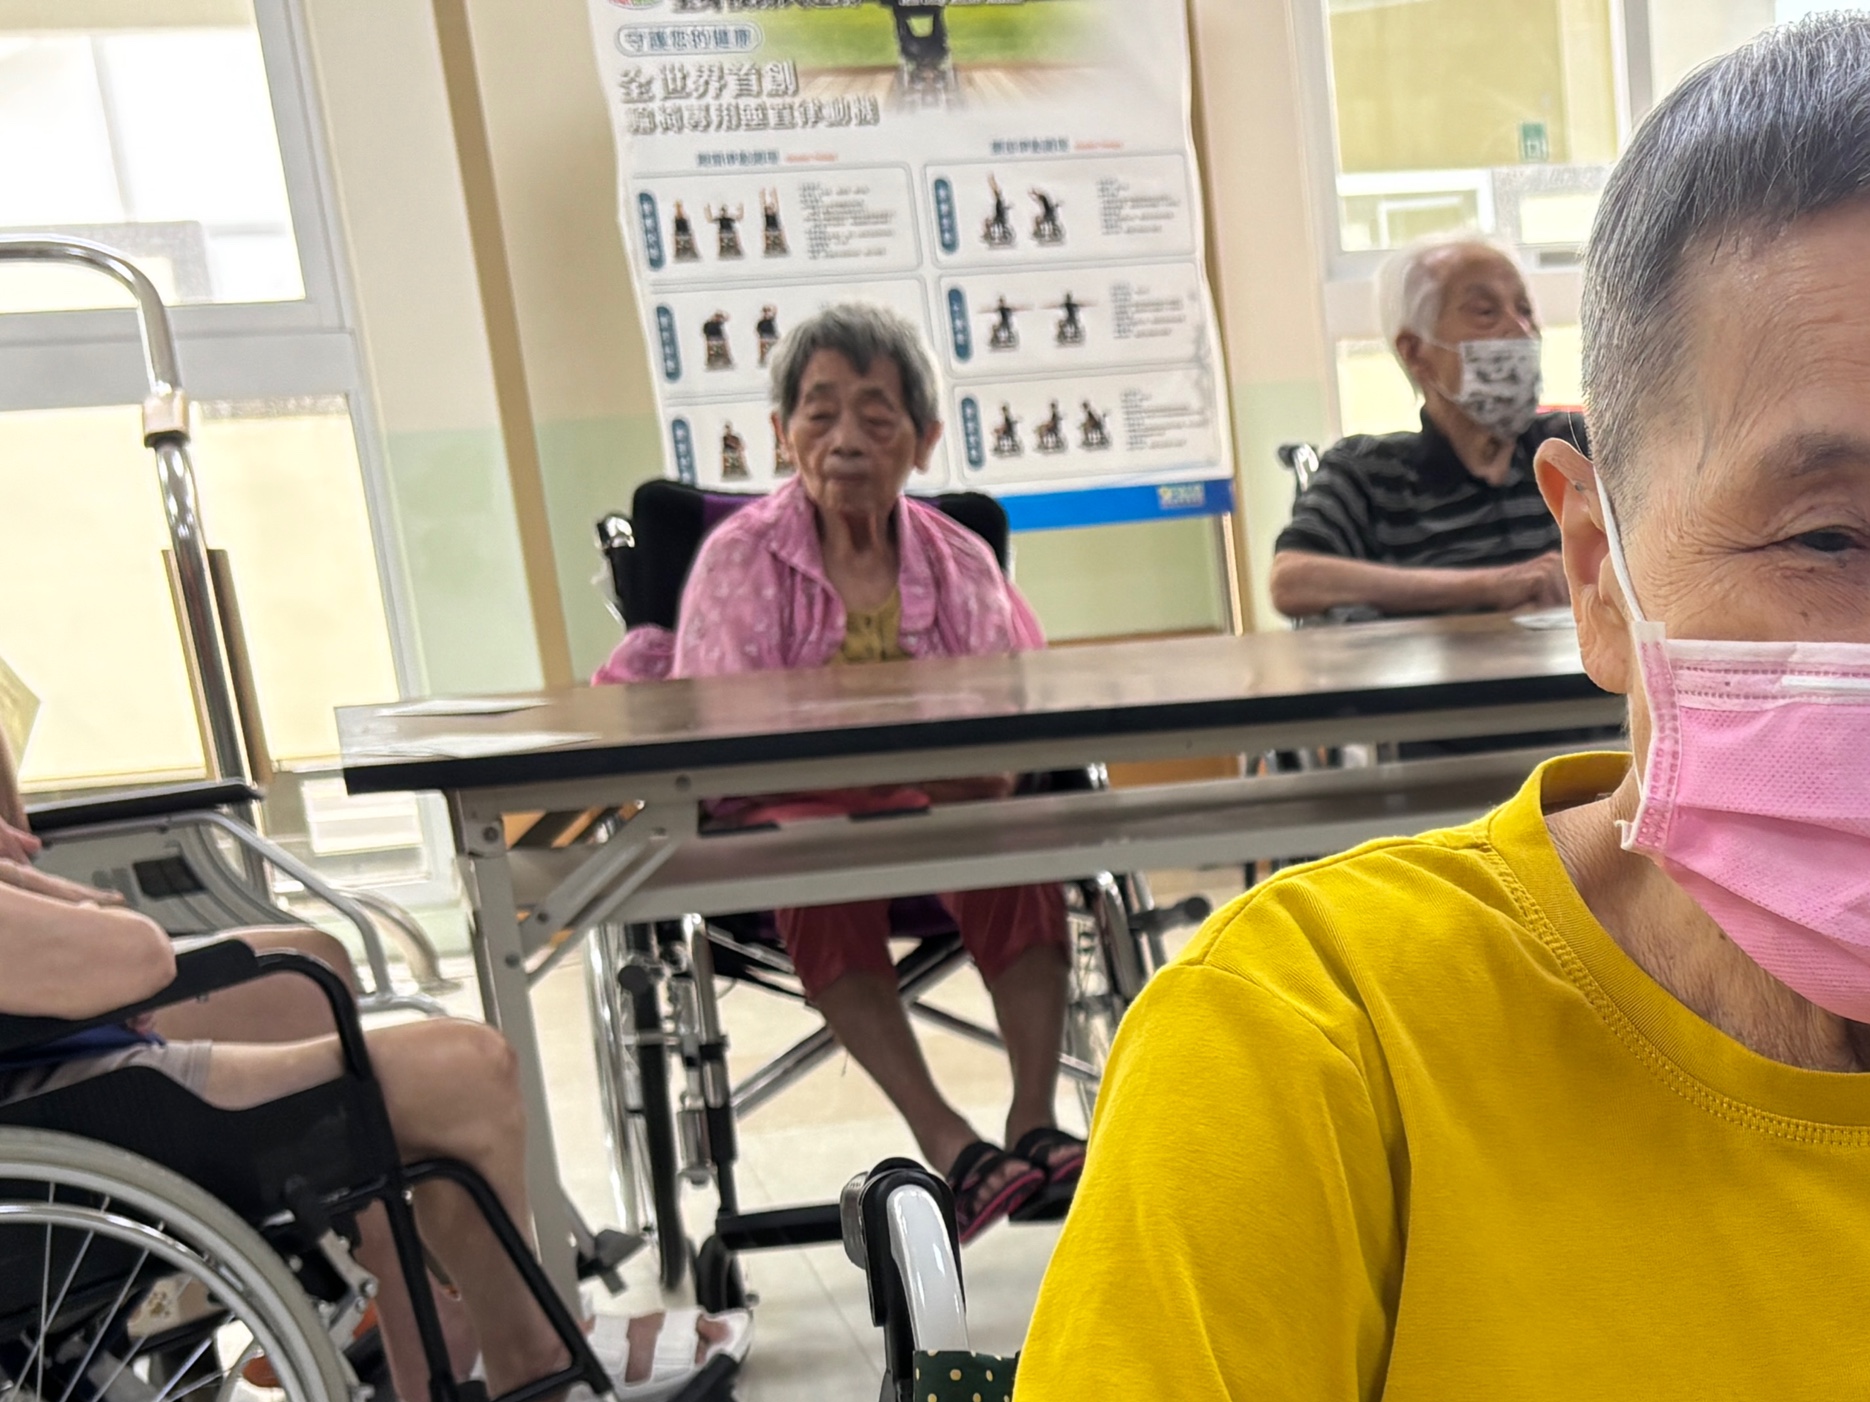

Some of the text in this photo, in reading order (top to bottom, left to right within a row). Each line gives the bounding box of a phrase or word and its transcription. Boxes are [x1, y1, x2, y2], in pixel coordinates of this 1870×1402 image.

[619, 60, 799, 103] 全世界首創
